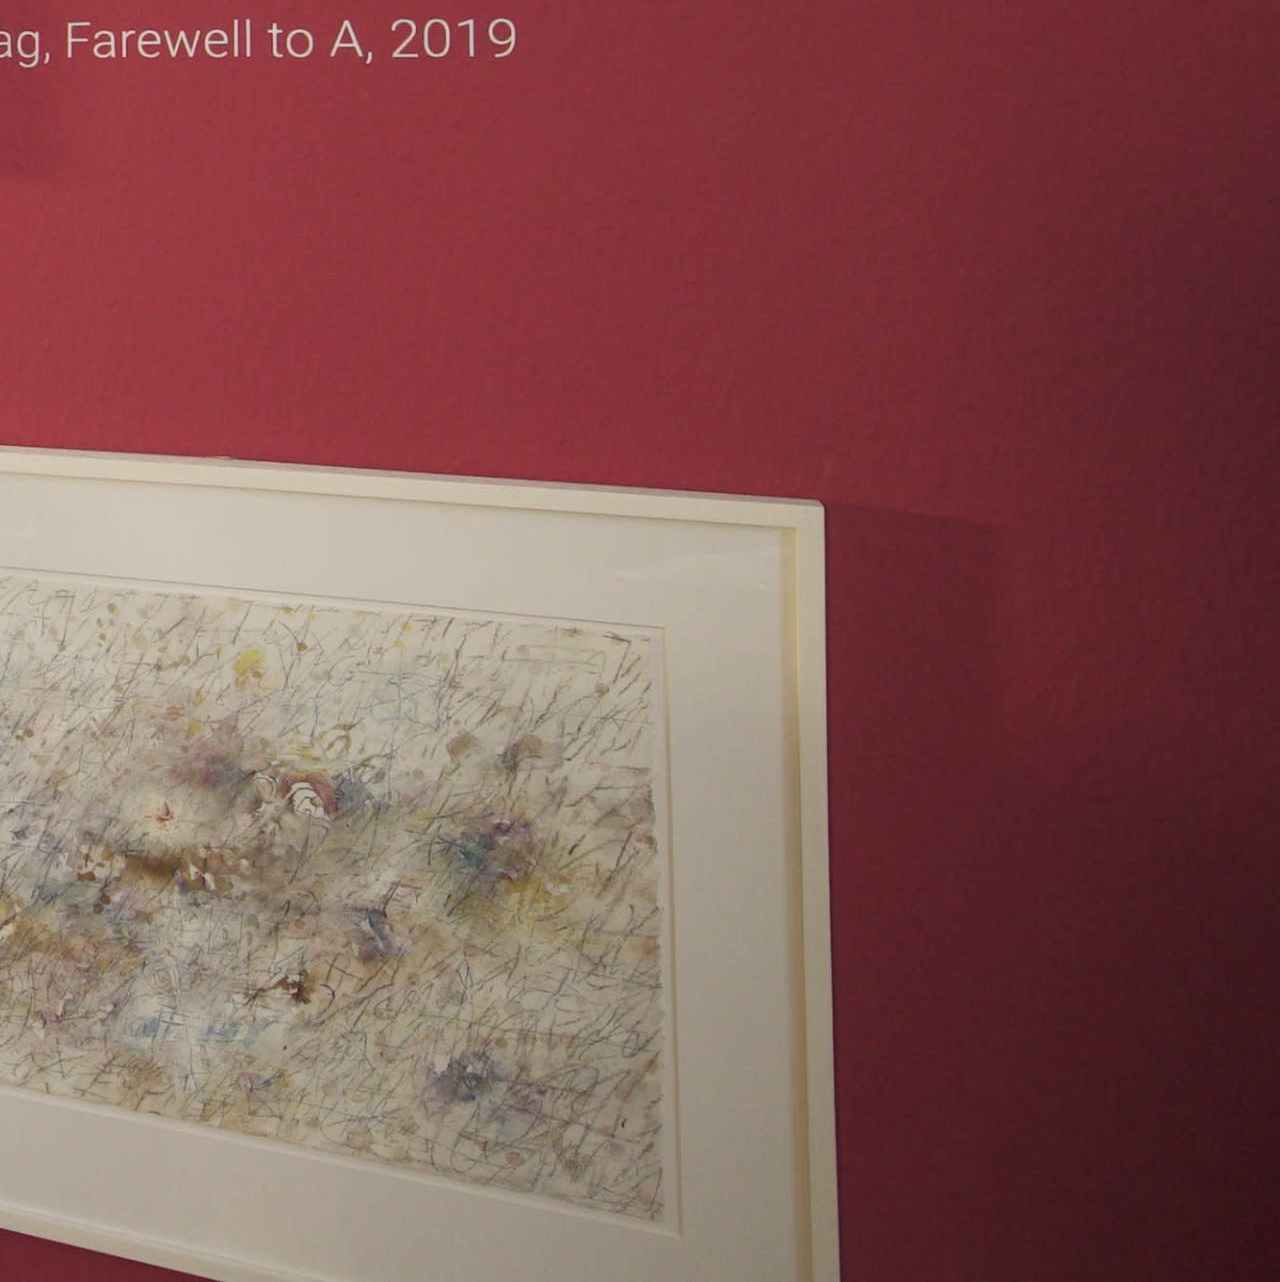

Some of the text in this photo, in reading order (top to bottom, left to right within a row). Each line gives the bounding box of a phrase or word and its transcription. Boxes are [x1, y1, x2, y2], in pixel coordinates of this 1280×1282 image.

[67, 19, 251, 58] Farewell
[267, 23, 313, 58] to
[330, 20, 372, 64] A,
[391, 18, 516, 58] 2019
